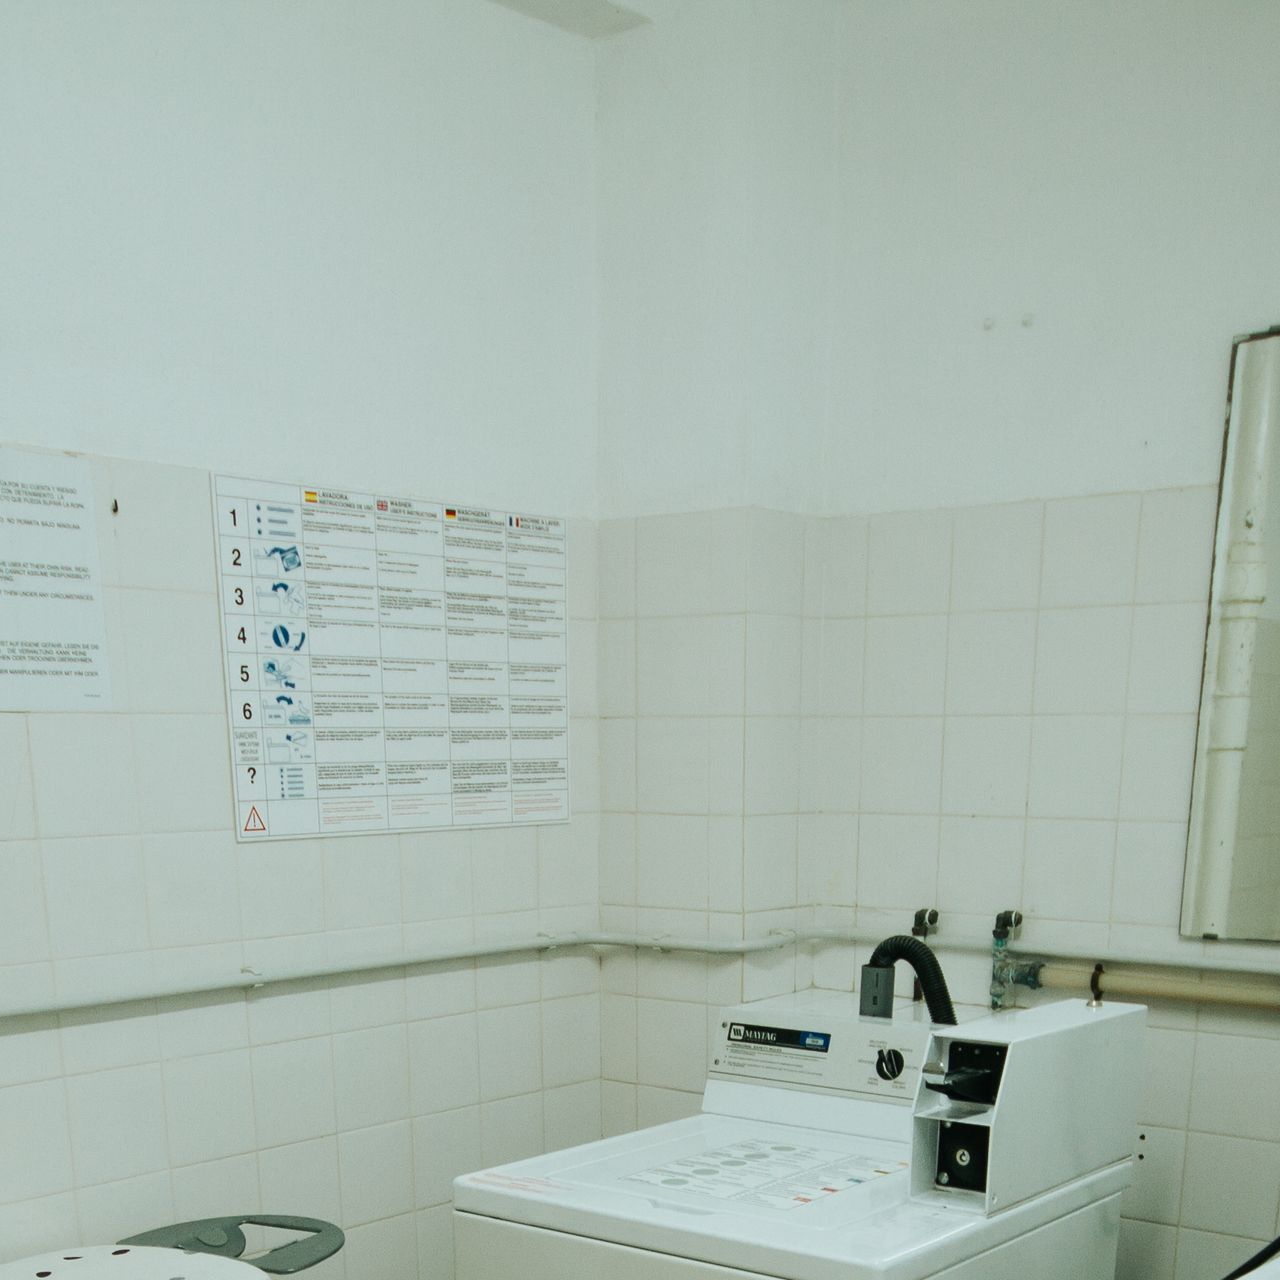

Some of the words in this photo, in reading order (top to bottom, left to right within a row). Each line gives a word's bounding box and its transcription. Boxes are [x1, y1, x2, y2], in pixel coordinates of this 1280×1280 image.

[229, 511, 238, 526] 1
[232, 549, 242, 566] 2
[234, 588, 245, 605] 3
[237, 626, 248, 644] 4
[240, 665, 250, 683] 5
[242, 703, 253, 720] 6
[744, 1030, 776, 1041] MAYTAG
